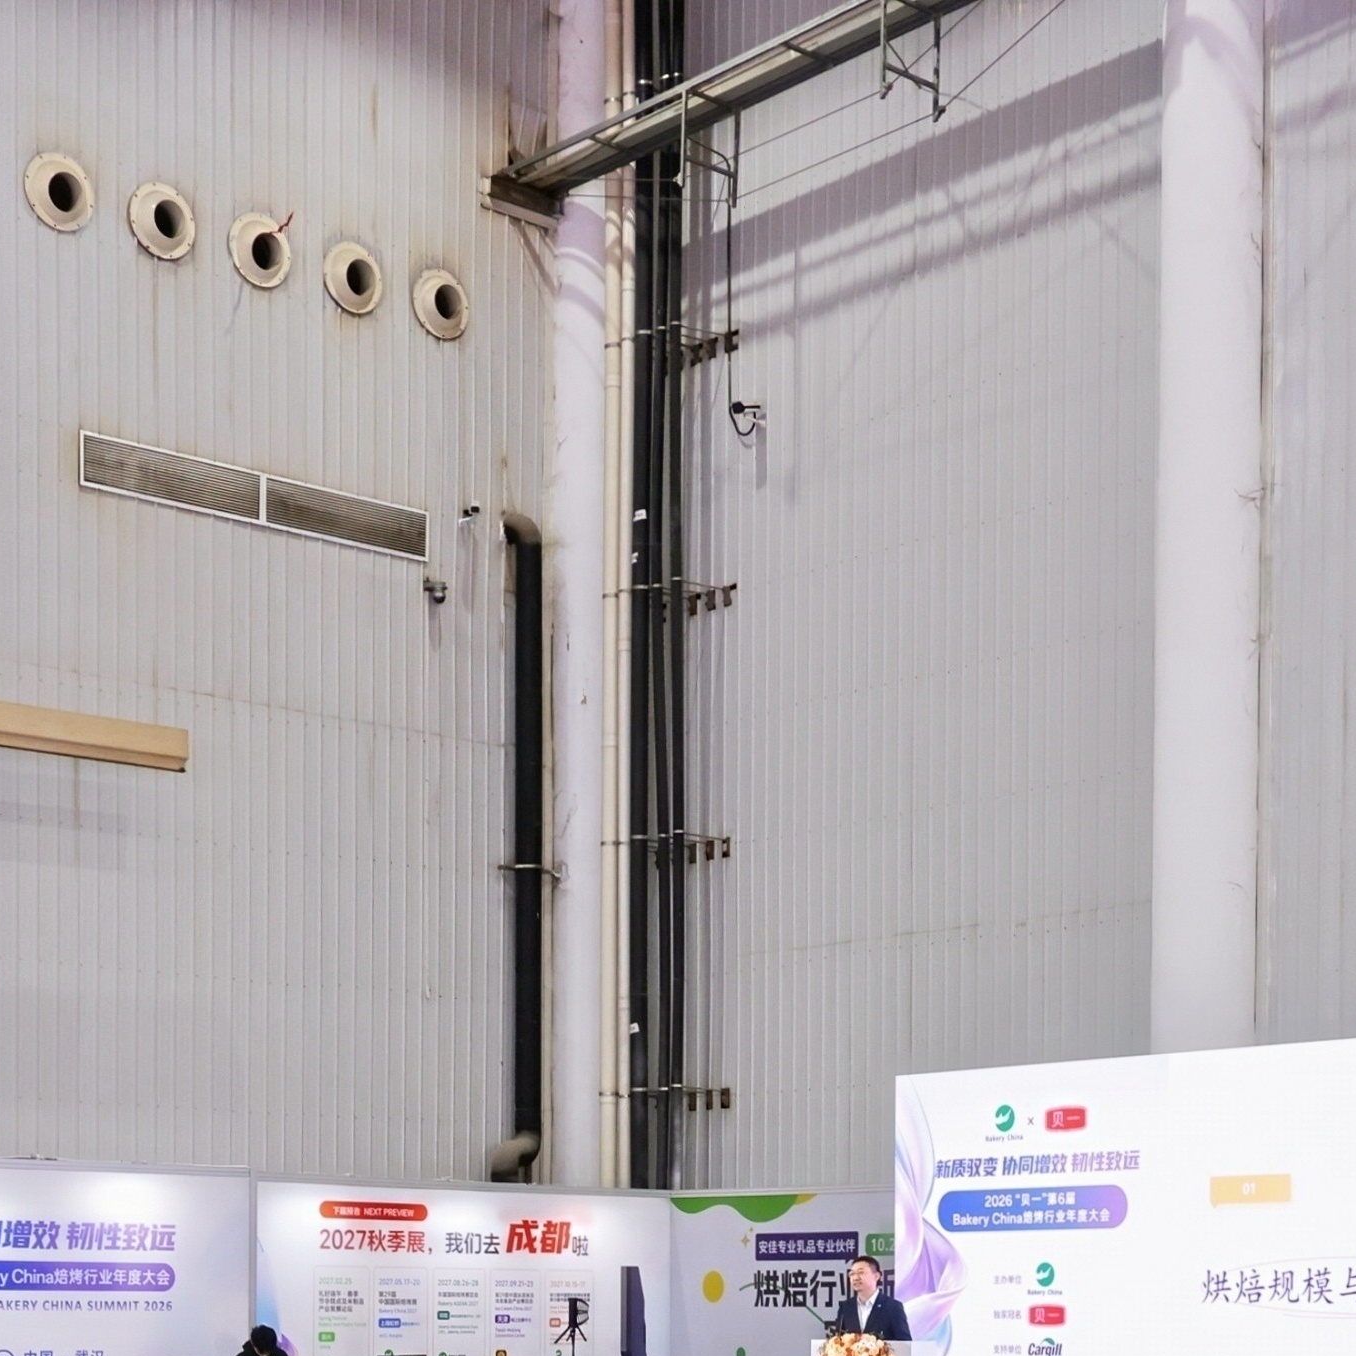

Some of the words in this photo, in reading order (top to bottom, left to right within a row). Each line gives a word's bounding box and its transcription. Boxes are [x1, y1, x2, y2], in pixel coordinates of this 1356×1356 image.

[1051, 1111, 1080, 1128] 贝一
[935, 1157, 998, 1179] 新质驭变
[1002, 1154, 1067, 1176] 协同增效
[1071, 1150, 1140, 1173] 韧性致远
[1242, 1182, 1256, 1195] 01
[985, 1194, 1013, 1208] 2026
[364, 1207, 382, 1216] NEXT
[383, 1208, 415, 1218] PREVIEW
[953, 1213, 989, 1228] Bakery
[66, 1221, 177, 1252] 韧性致远
[758, 1238, 856, 1254] 安佳专业乳品专业伙伴
[993, 1275, 1022, 1285] 主办单位
[42, 1301, 83, 1312] CHINA
[87, 1301, 139, 1312] SUMMIT
[144, 1301, 173, 1312] 2026
[1034, 1307, 1060, 1323] 贝一
